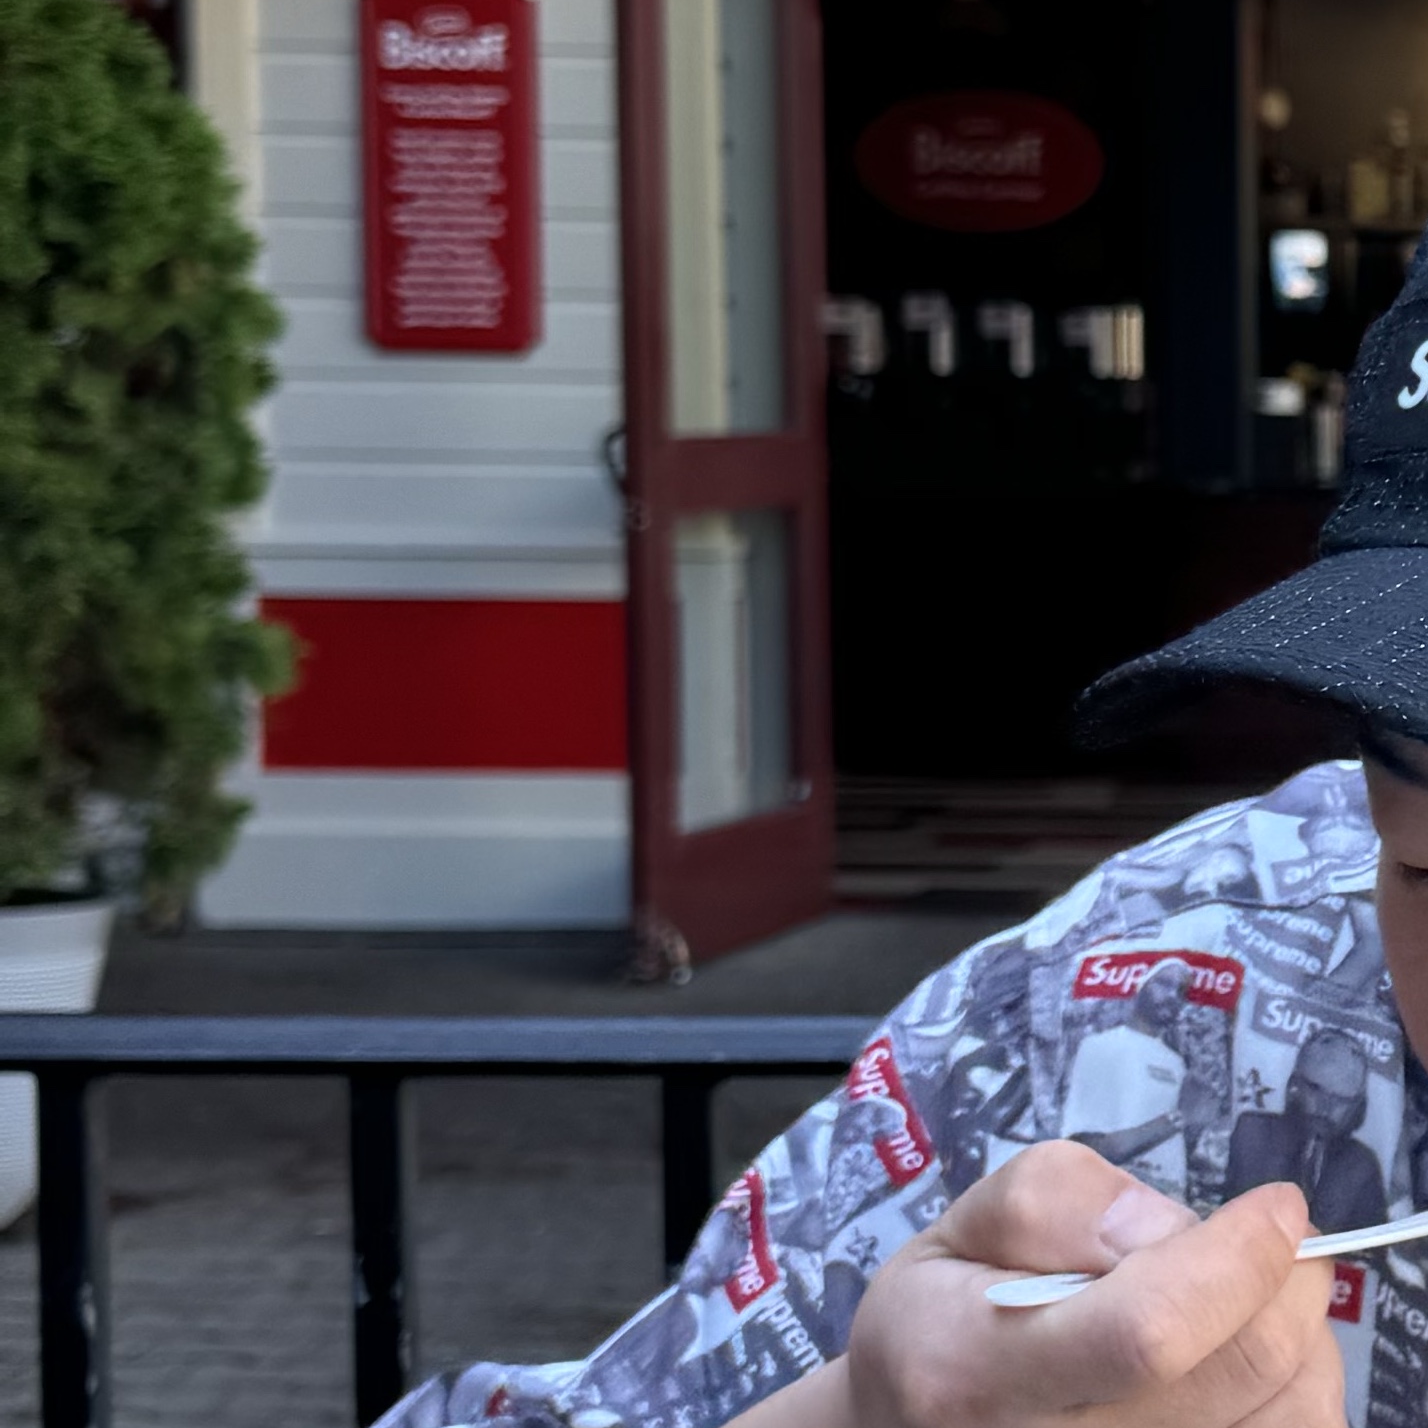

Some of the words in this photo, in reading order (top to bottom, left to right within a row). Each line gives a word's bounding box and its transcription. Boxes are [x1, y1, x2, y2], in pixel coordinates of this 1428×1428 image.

[1084, 958, 1238, 995] Supme
[1262, 999, 1396, 1063] Supme
[856, 1046, 924, 1173] Supme
